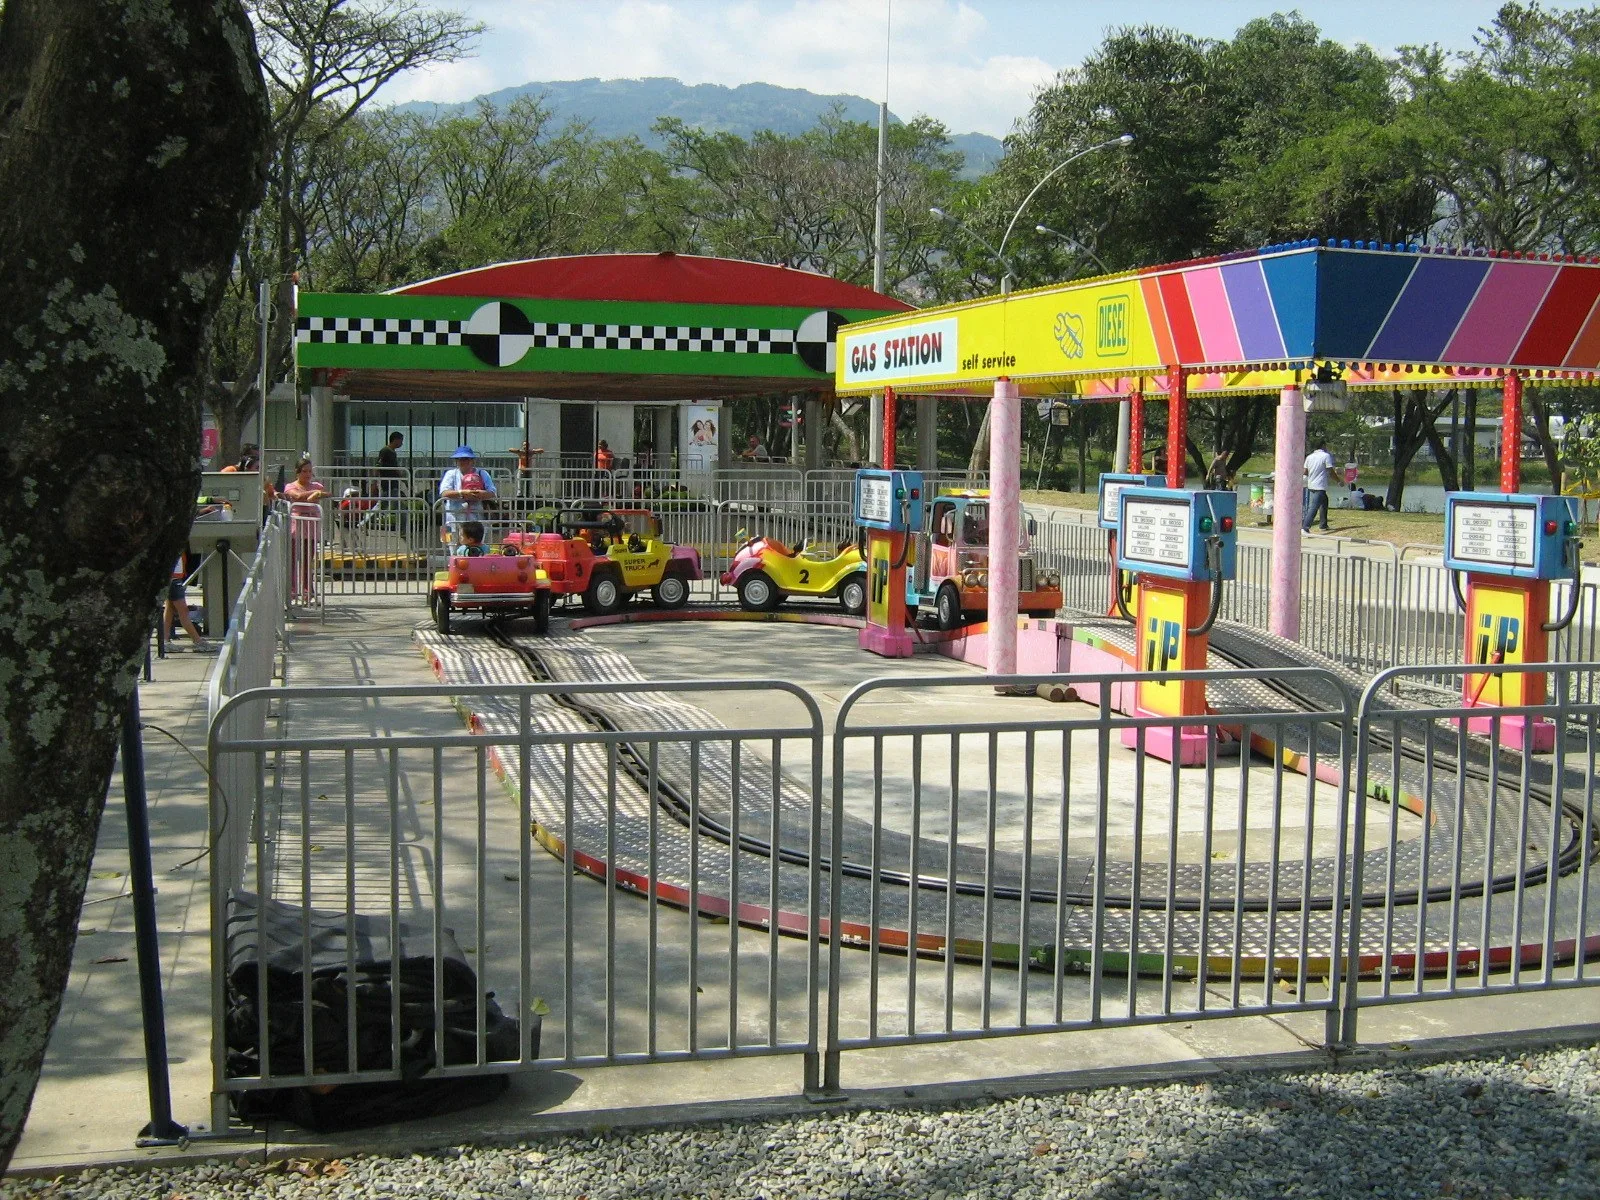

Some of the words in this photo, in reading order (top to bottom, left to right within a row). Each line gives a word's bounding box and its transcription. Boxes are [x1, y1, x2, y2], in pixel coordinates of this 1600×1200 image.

[1098, 302, 1127, 349] DIESEL
[851, 343, 877, 374] GAS
[883, 331, 943, 371] STATION
[962, 354, 979, 371] self
[981, 351, 1017, 369] service
[575, 562, 584, 578] 3
[624, 564, 646, 573] TRUCK
[798, 569, 811, 585] 2
